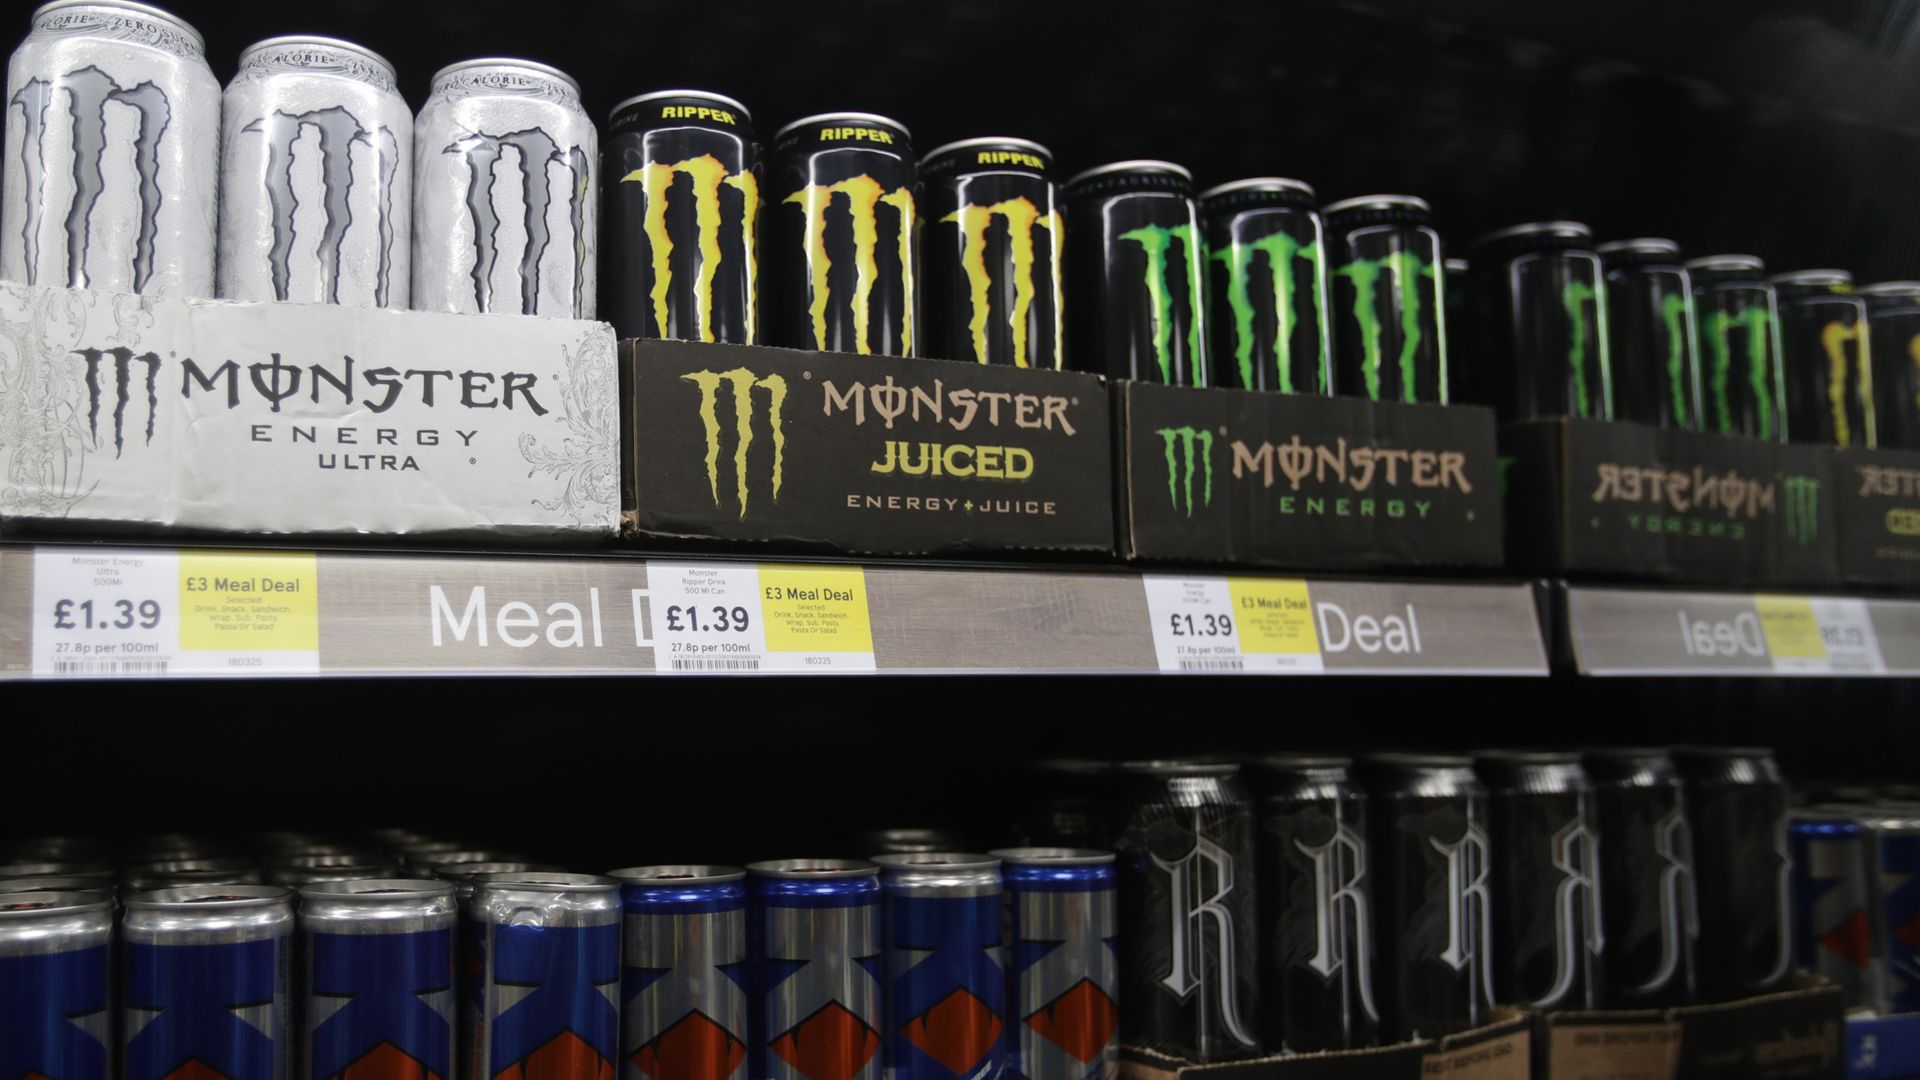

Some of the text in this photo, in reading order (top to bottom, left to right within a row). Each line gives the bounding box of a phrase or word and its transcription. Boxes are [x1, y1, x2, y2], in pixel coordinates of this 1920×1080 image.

[114, 17, 157, 34] ZERO
[662, 106, 736, 125] RIPPER
[820, 127, 893, 144] RIPPER
[978, 152, 1045, 170] RIPPER
[180, 353, 549, 416] MONSTER
[822, 375, 1077, 436] MONSTER
[250, 424, 479, 446] ENERGY
[318, 453, 420, 472] ULTRA
[871, 440, 1034, 479] JUICED
[1231, 435, 1472, 494] MONSTER
[1279, 496, 1431, 519] ENERGY
[96, 567, 120, 576] Ultra
[689, 569, 718, 577] Monster
[186, 577, 300, 592] £3 Meal Deal
[682, 578, 726, 587] Ripper Drink
[685, 587, 700, 595] 500
[225, 596, 262, 604] Selected
[765, 587, 854, 601] £3 Meal Deal
[1257, 597, 1282, 609] Meal
[1284, 597, 1308, 610] Deal
[54, 599, 161, 629] £1.39
[430, 585, 602, 648] Meal
[667, 605, 749, 632] £1.39
[1170, 613, 1233, 637] £1.39
[1316, 602, 1420, 655] Deal
[56, 642, 159, 654] 27.8p per 100ml
[671, 643, 750, 654] 27.8p per 100ml
[805, 657, 831, 665] 180325
